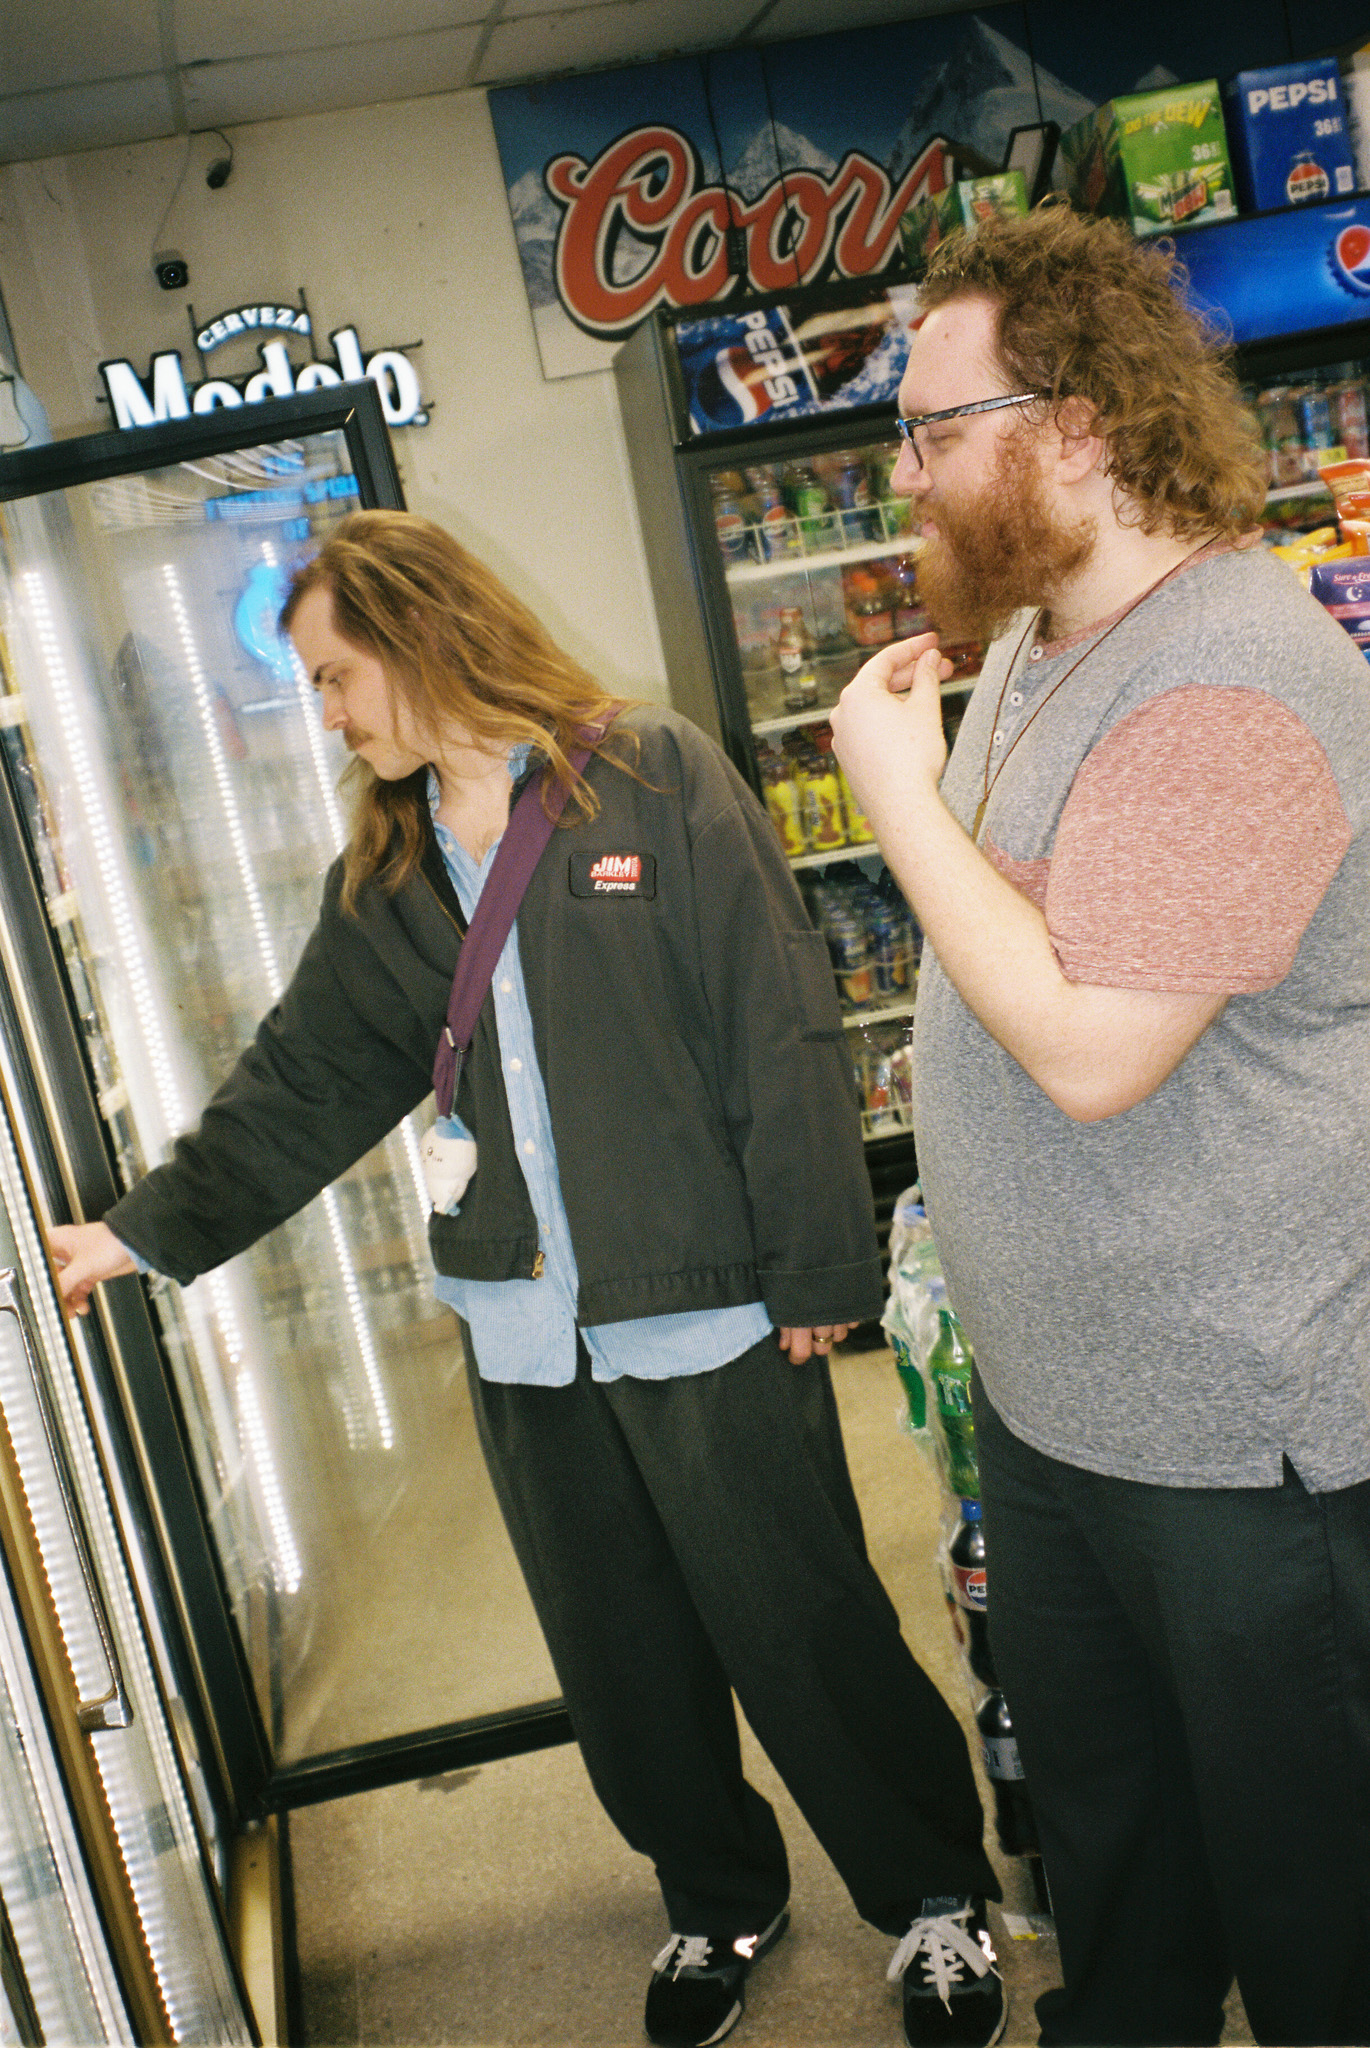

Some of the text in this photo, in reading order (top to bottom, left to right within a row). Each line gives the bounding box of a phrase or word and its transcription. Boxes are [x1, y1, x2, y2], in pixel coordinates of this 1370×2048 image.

[1248, 77, 1338, 115] PEPSI
[1313, 117, 1333, 138] 36
[548, 126, 960, 334] Coor
[197, 306, 311, 350] CERVEZA
[736, 310, 800, 409] PEPSI
[592, 856, 632, 872] JIM
[594, 880, 636, 892] Express
